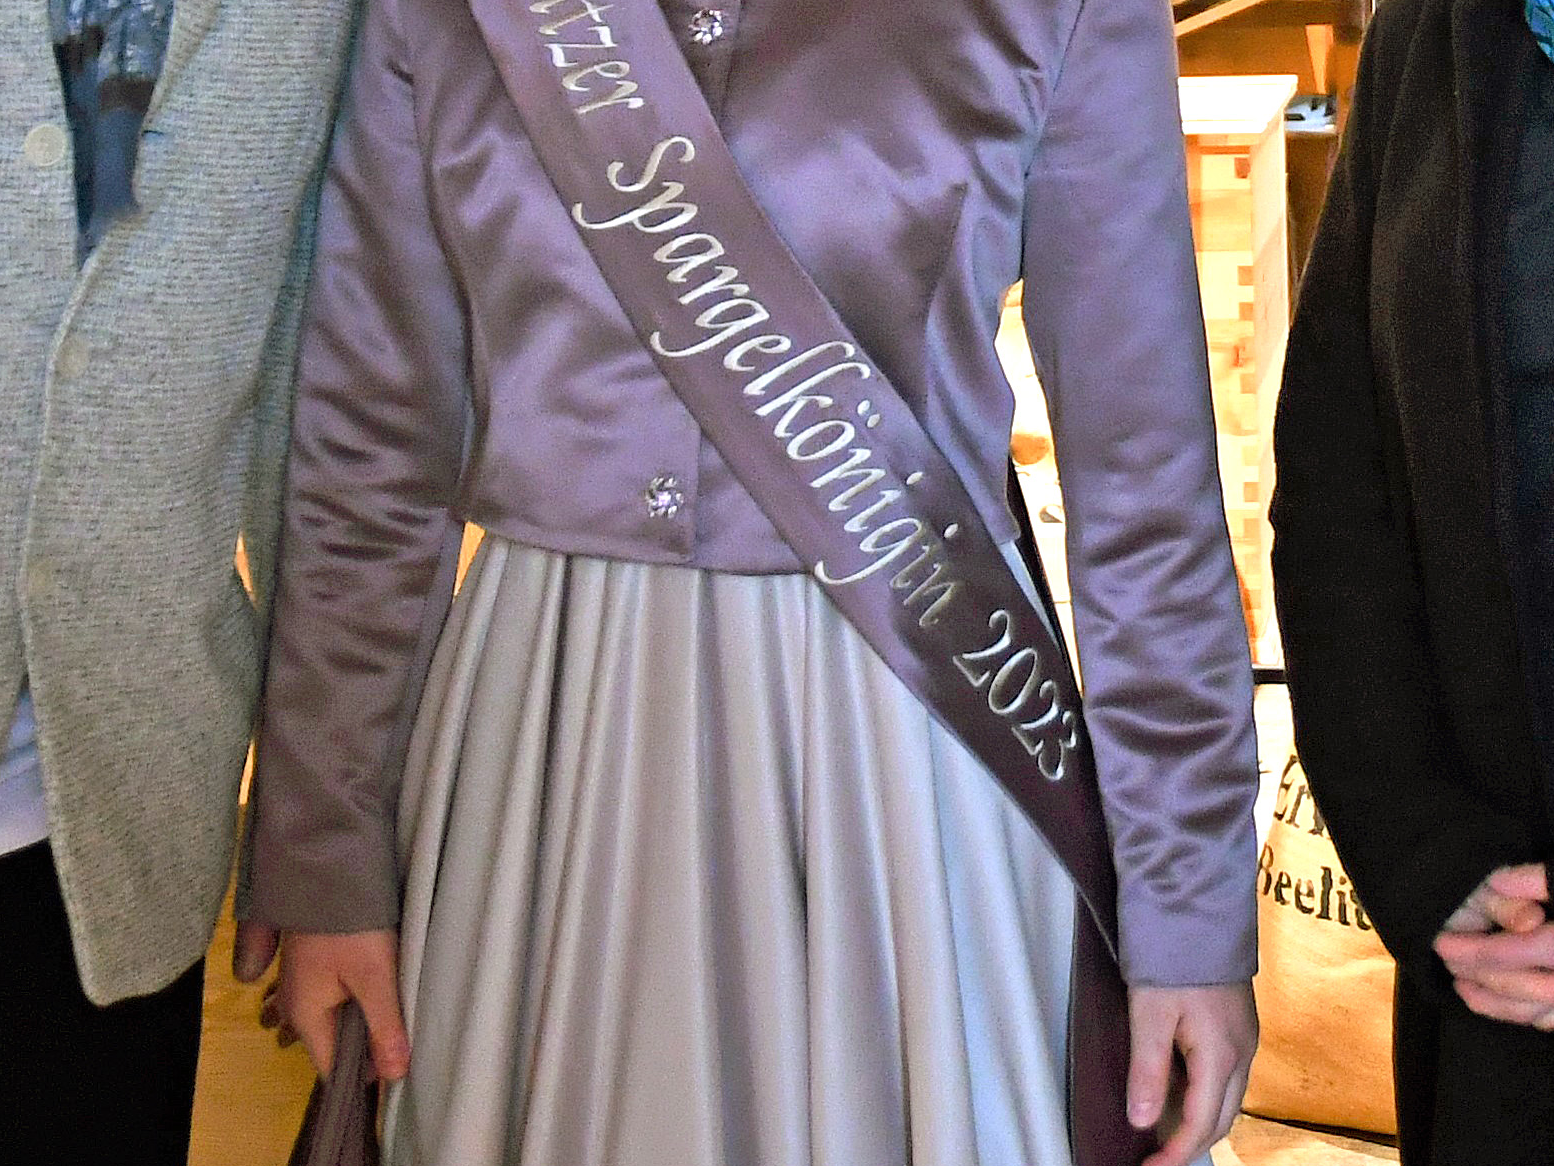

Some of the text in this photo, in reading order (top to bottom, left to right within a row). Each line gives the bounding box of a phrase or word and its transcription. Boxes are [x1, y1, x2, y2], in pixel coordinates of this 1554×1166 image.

[573, 134, 965, 628] Spargelkönigin
[952, 607, 1083, 781] 2023
[1257, 842, 1372, 931] Beelit
